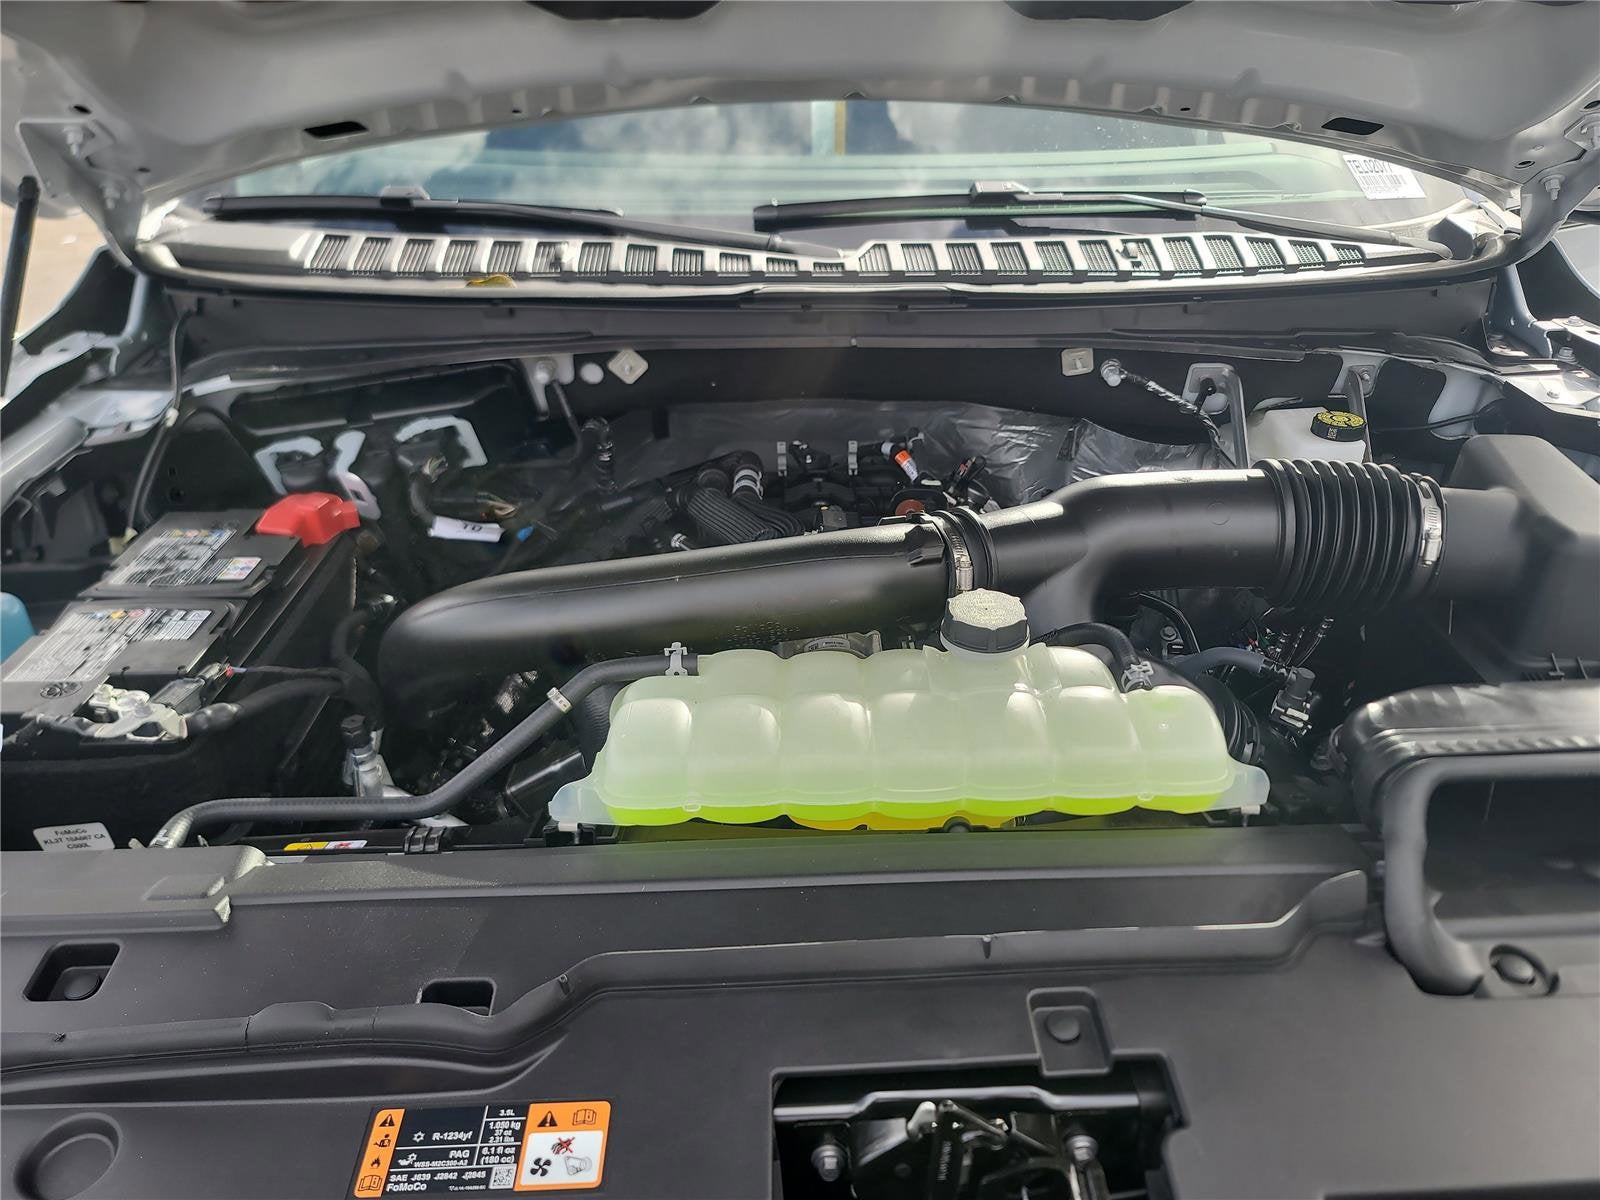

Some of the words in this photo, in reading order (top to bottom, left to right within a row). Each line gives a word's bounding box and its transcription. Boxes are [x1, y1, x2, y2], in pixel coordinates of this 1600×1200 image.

[488, 1121, 510, 1130] 1.050
[511, 1121, 521, 1130] kg
[432, 1131, 473, 1142] R-1234yf
[449, 1150, 470, 1159] PAG
[480, 1156, 500, 1165] (180
[500, 1155, 515, 1164] cc)
[389, 1174, 409, 1182] SAE
[386, 1182, 428, 1192] FoMoCo
